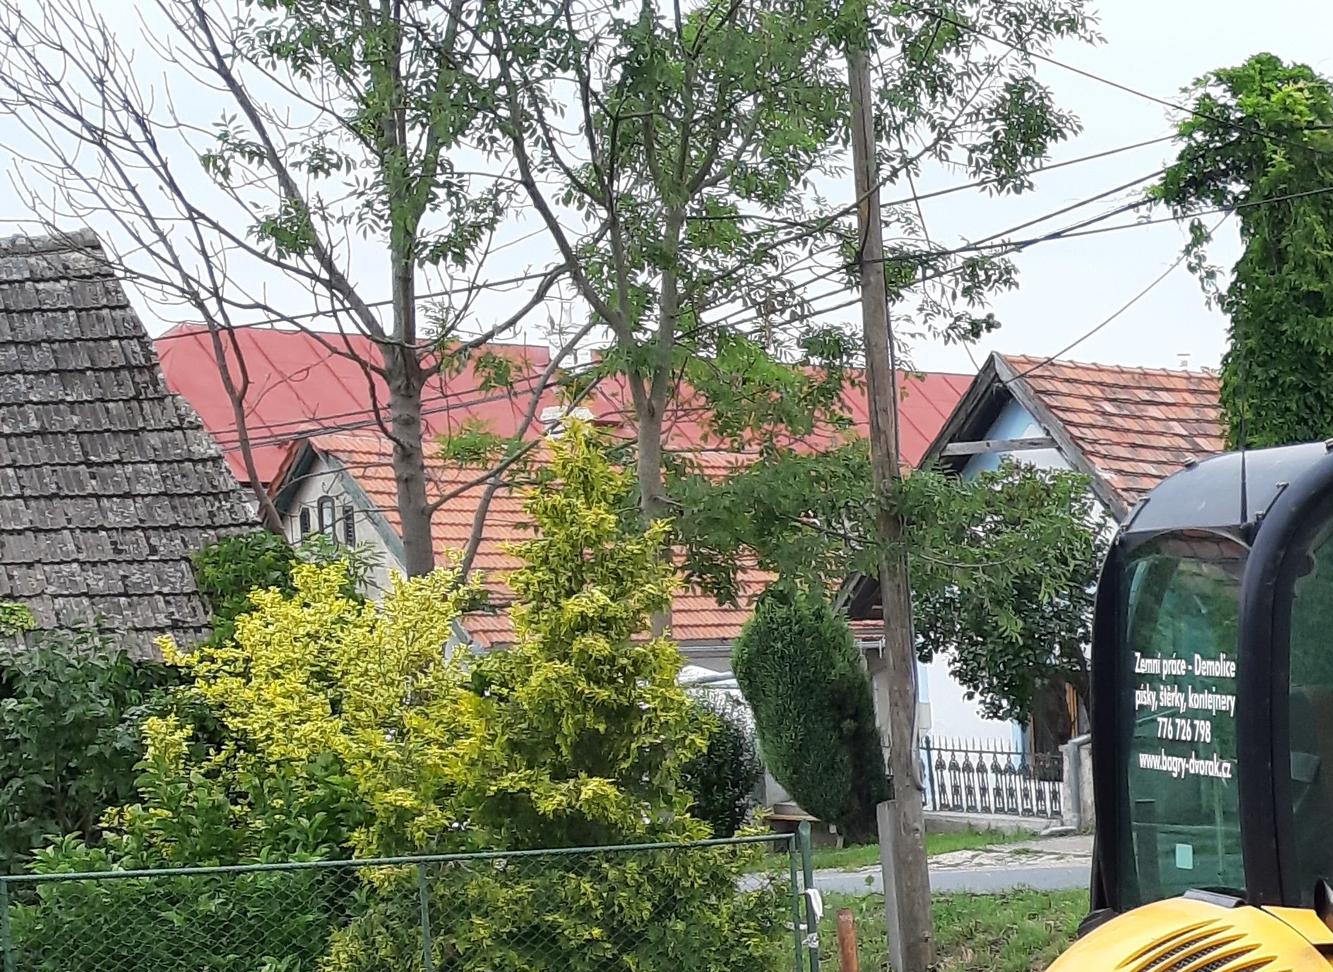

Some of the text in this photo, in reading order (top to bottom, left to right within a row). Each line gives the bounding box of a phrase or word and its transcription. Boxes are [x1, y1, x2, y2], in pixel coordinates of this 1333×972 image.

[1135, 652, 1160, 674] Zemní
[1162, 652, 1187, 680] práce
[1194, 652, 1236, 678] Demolice
[1136, 683, 1236, 717] písky, štěrky, kontejnery
[1157, 717, 1211, 743] 776 726 798
[1139, 748, 1232, 779] www.bagry-dvorak.cz
